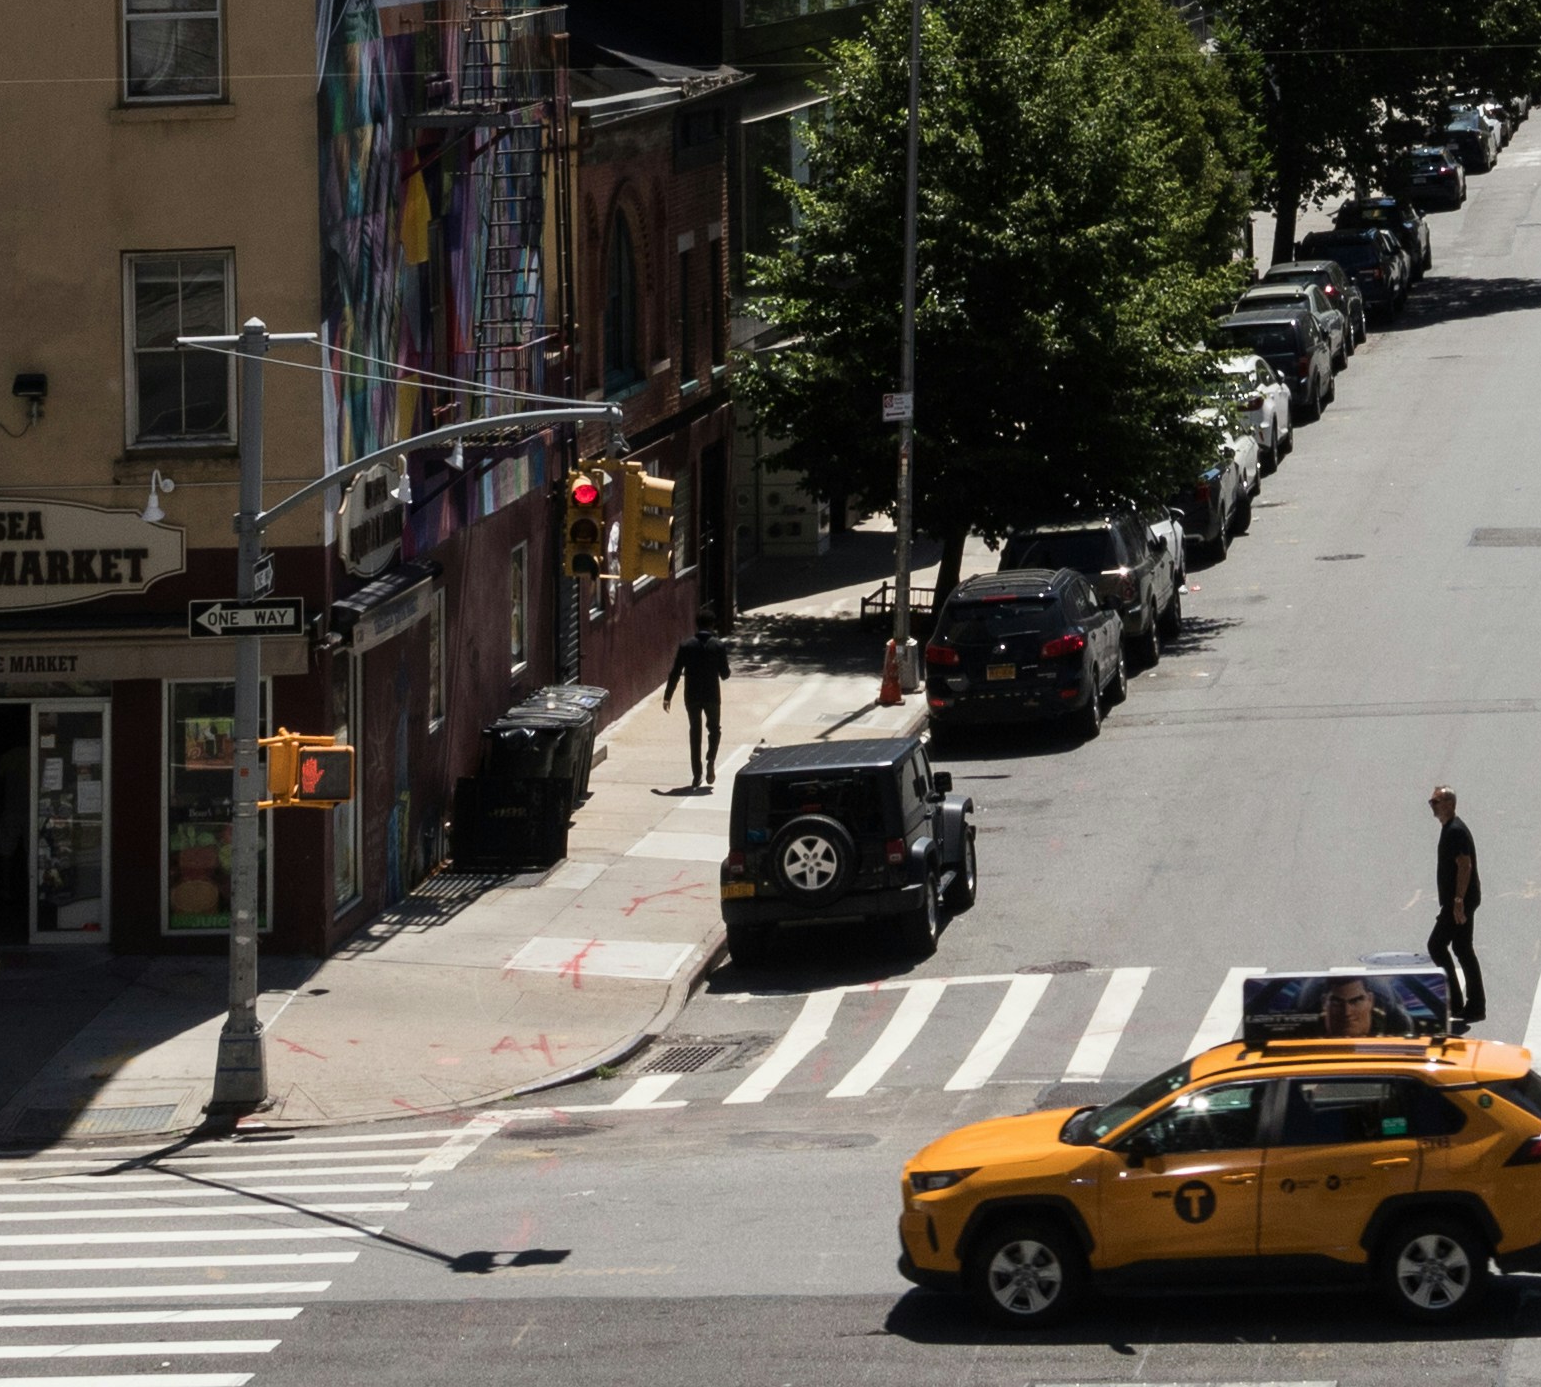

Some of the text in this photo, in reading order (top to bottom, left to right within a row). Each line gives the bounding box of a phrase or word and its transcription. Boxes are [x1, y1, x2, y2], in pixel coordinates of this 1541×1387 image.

[208, 610, 289, 626] ONE WAY
[10, 655, 78, 673] MARKET
[1182, 1188, 1208, 1219] T
